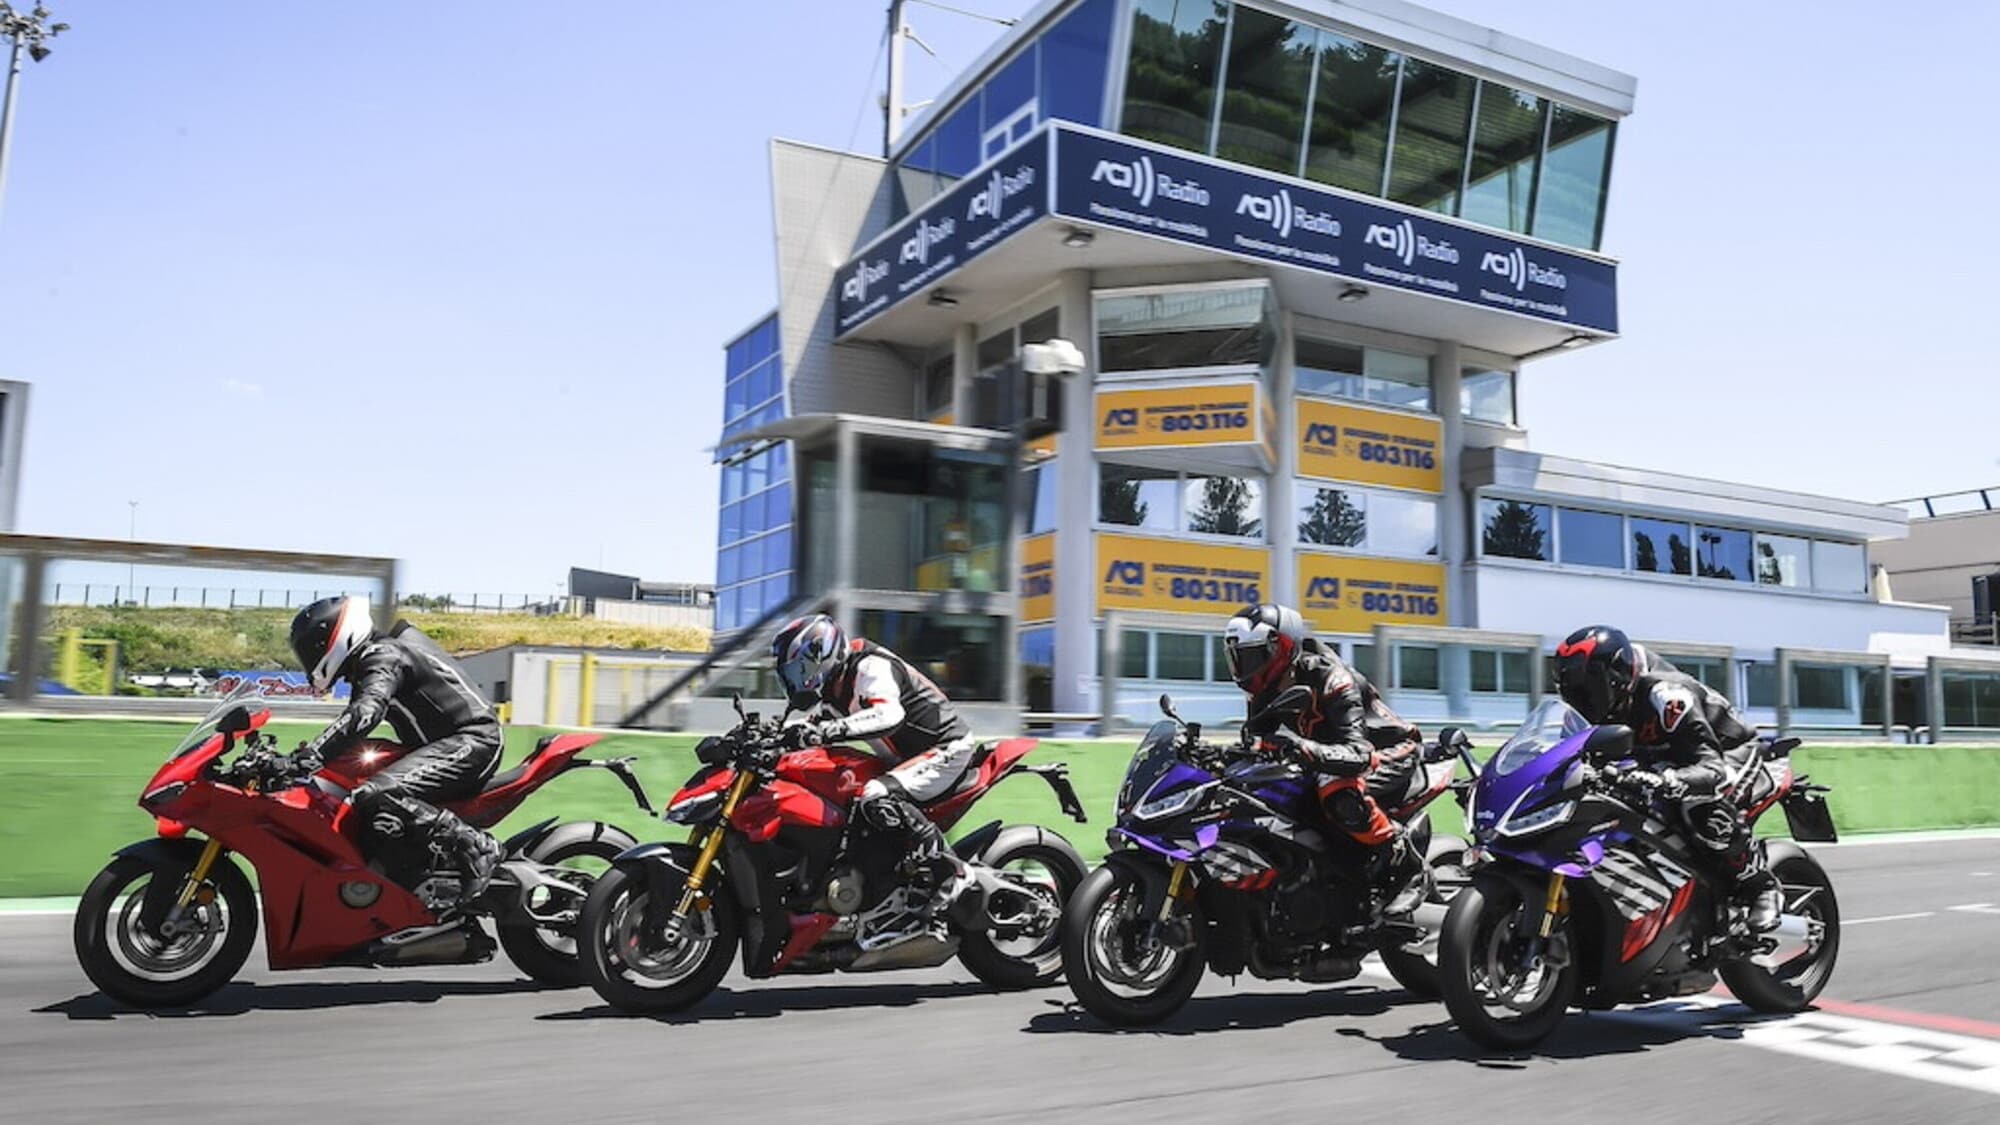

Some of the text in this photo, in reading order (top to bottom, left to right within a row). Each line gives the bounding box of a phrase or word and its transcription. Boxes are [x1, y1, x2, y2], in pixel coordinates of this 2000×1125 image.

[1157, 172, 1210, 206] Radio
[1294, 205, 1341, 237] Radio
[1416, 234, 1459, 264] Radio
[1527, 261, 1567, 289] Radio
[1103, 408, 1139, 428] ACI
[1303, 422, 1337, 447] ACI
[1105, 559, 1145, 586] ACI
[1305, 575, 1340, 599] ACI
